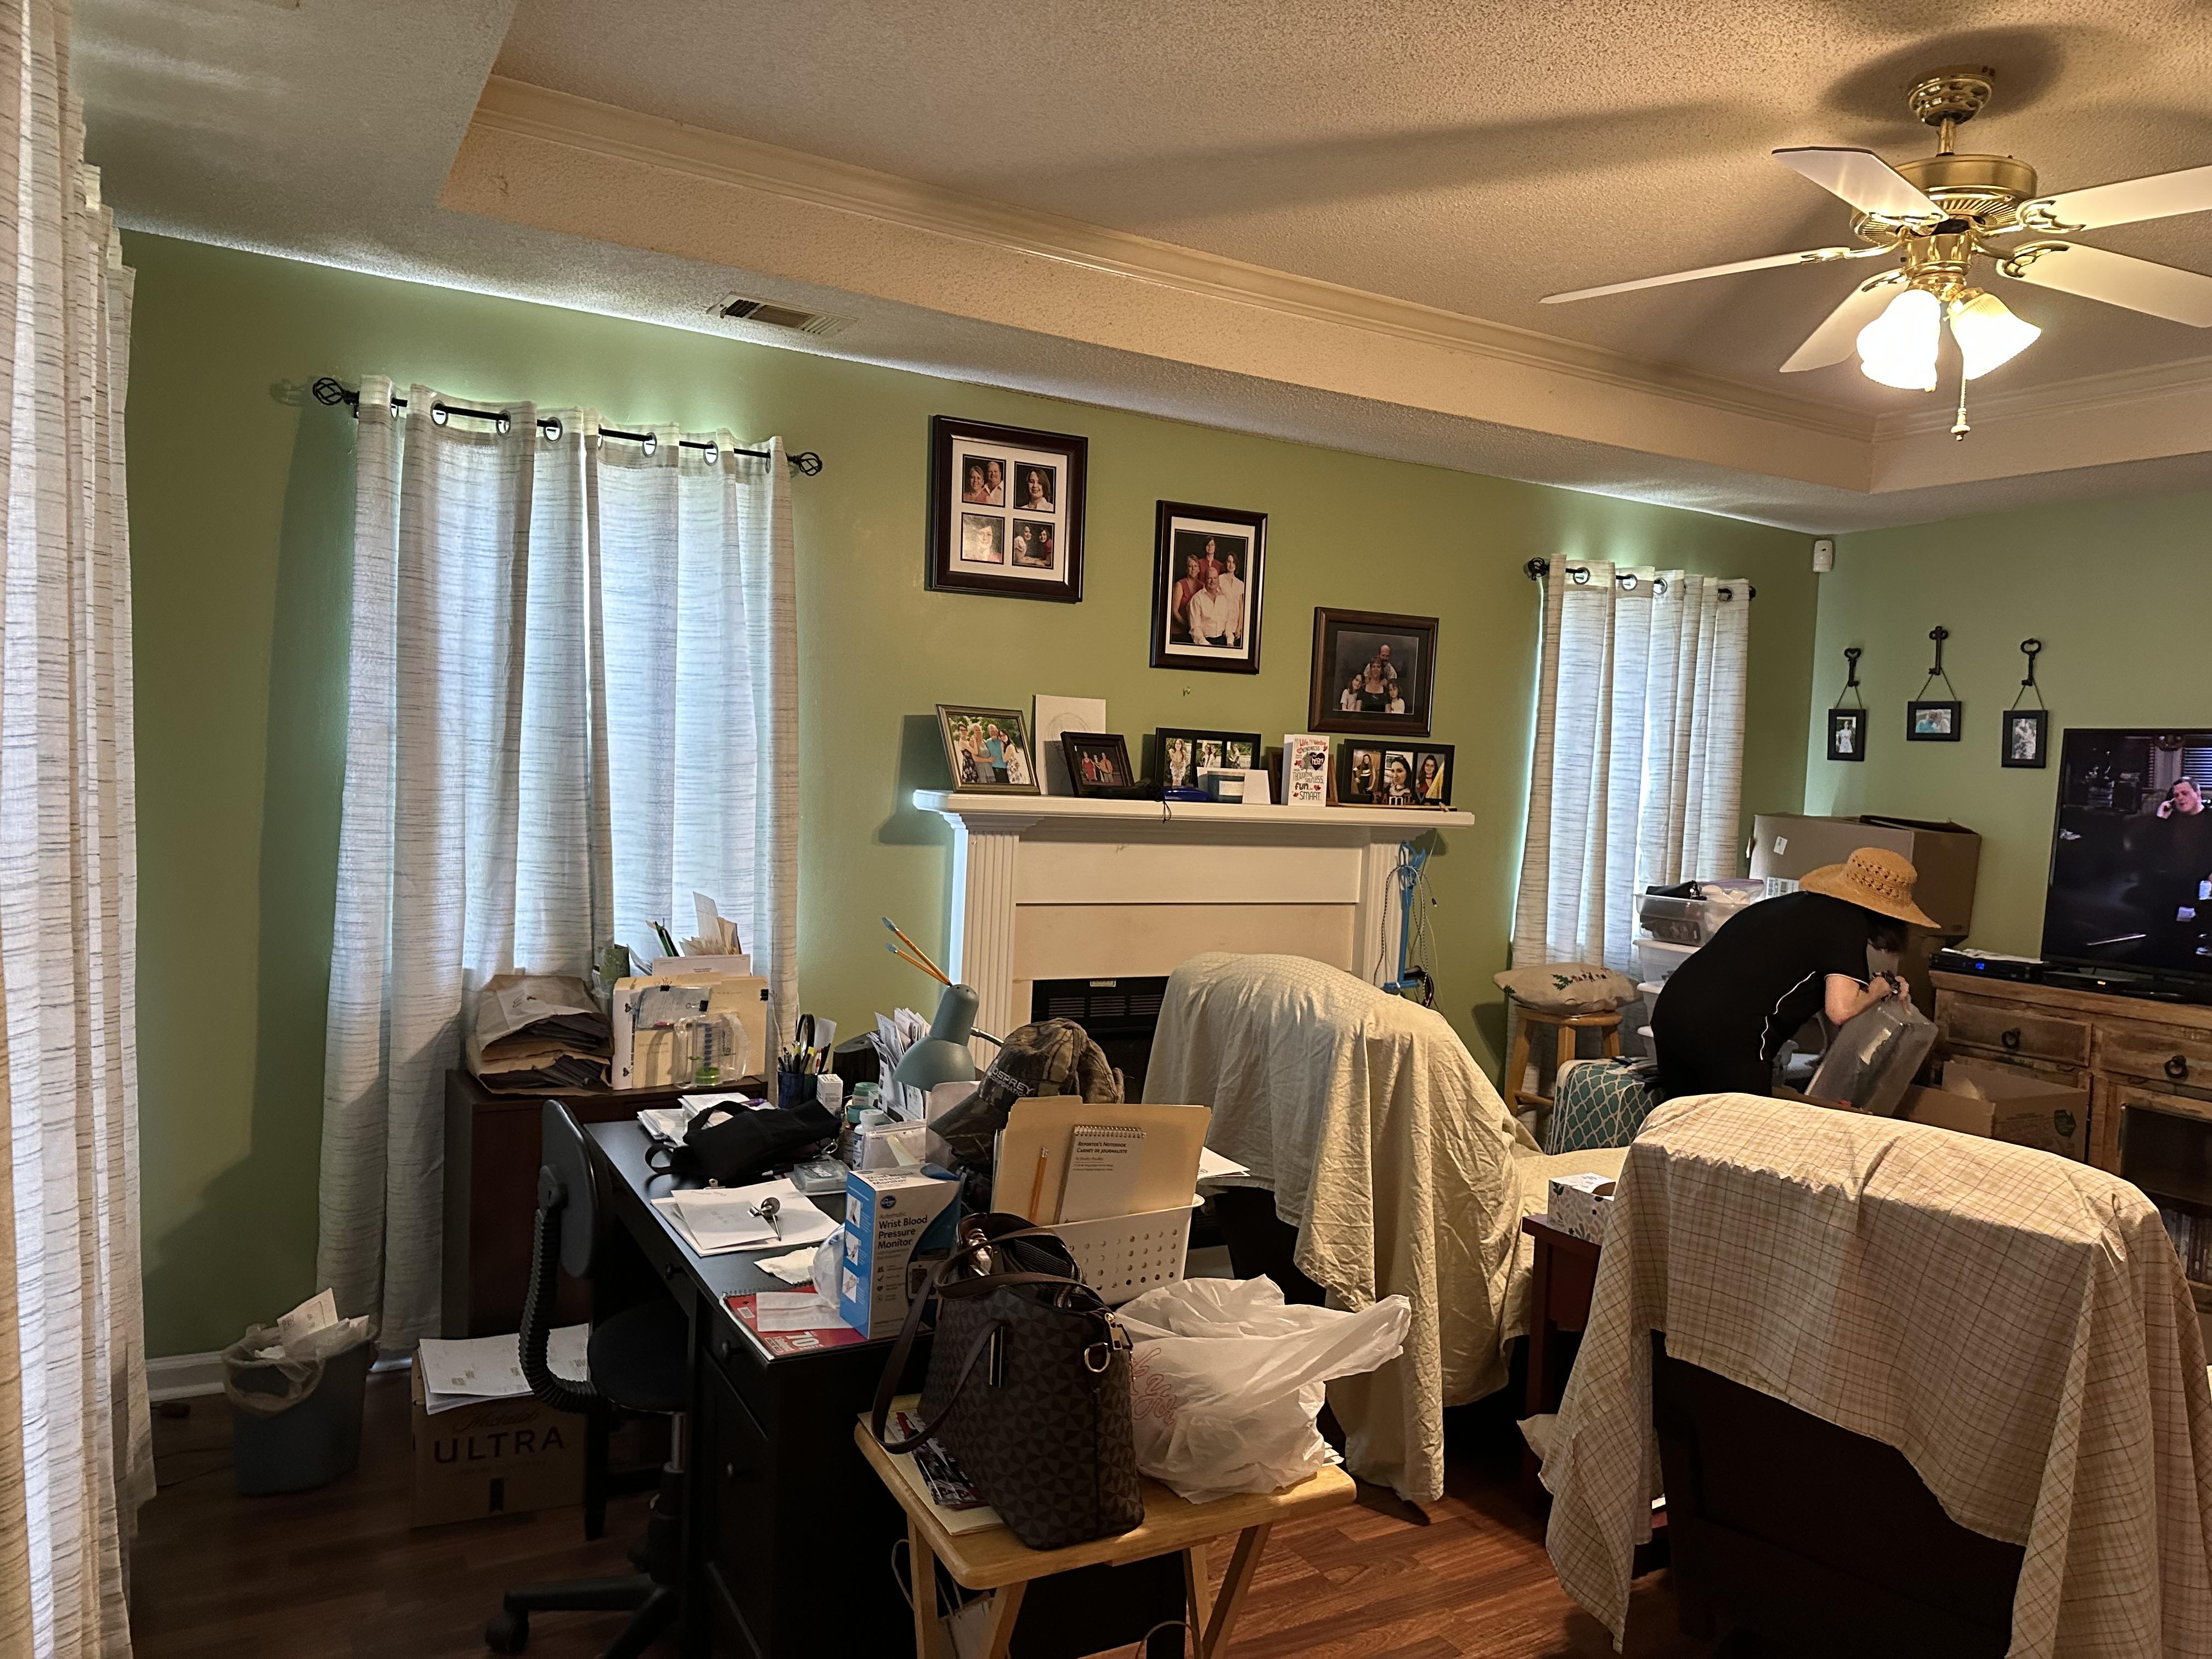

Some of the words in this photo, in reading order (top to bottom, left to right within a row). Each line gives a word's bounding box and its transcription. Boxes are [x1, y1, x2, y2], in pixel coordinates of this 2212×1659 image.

[991, 1065, 1035, 1095] OSPREY
[879, 1219, 901, 1229] Wrist
[904, 1215, 928, 1226] Blood
[878, 1228, 916, 1240] Pressure
[878, 1238, 913, 1249] Monitor
[434, 1426, 565, 1464] ULTRA
